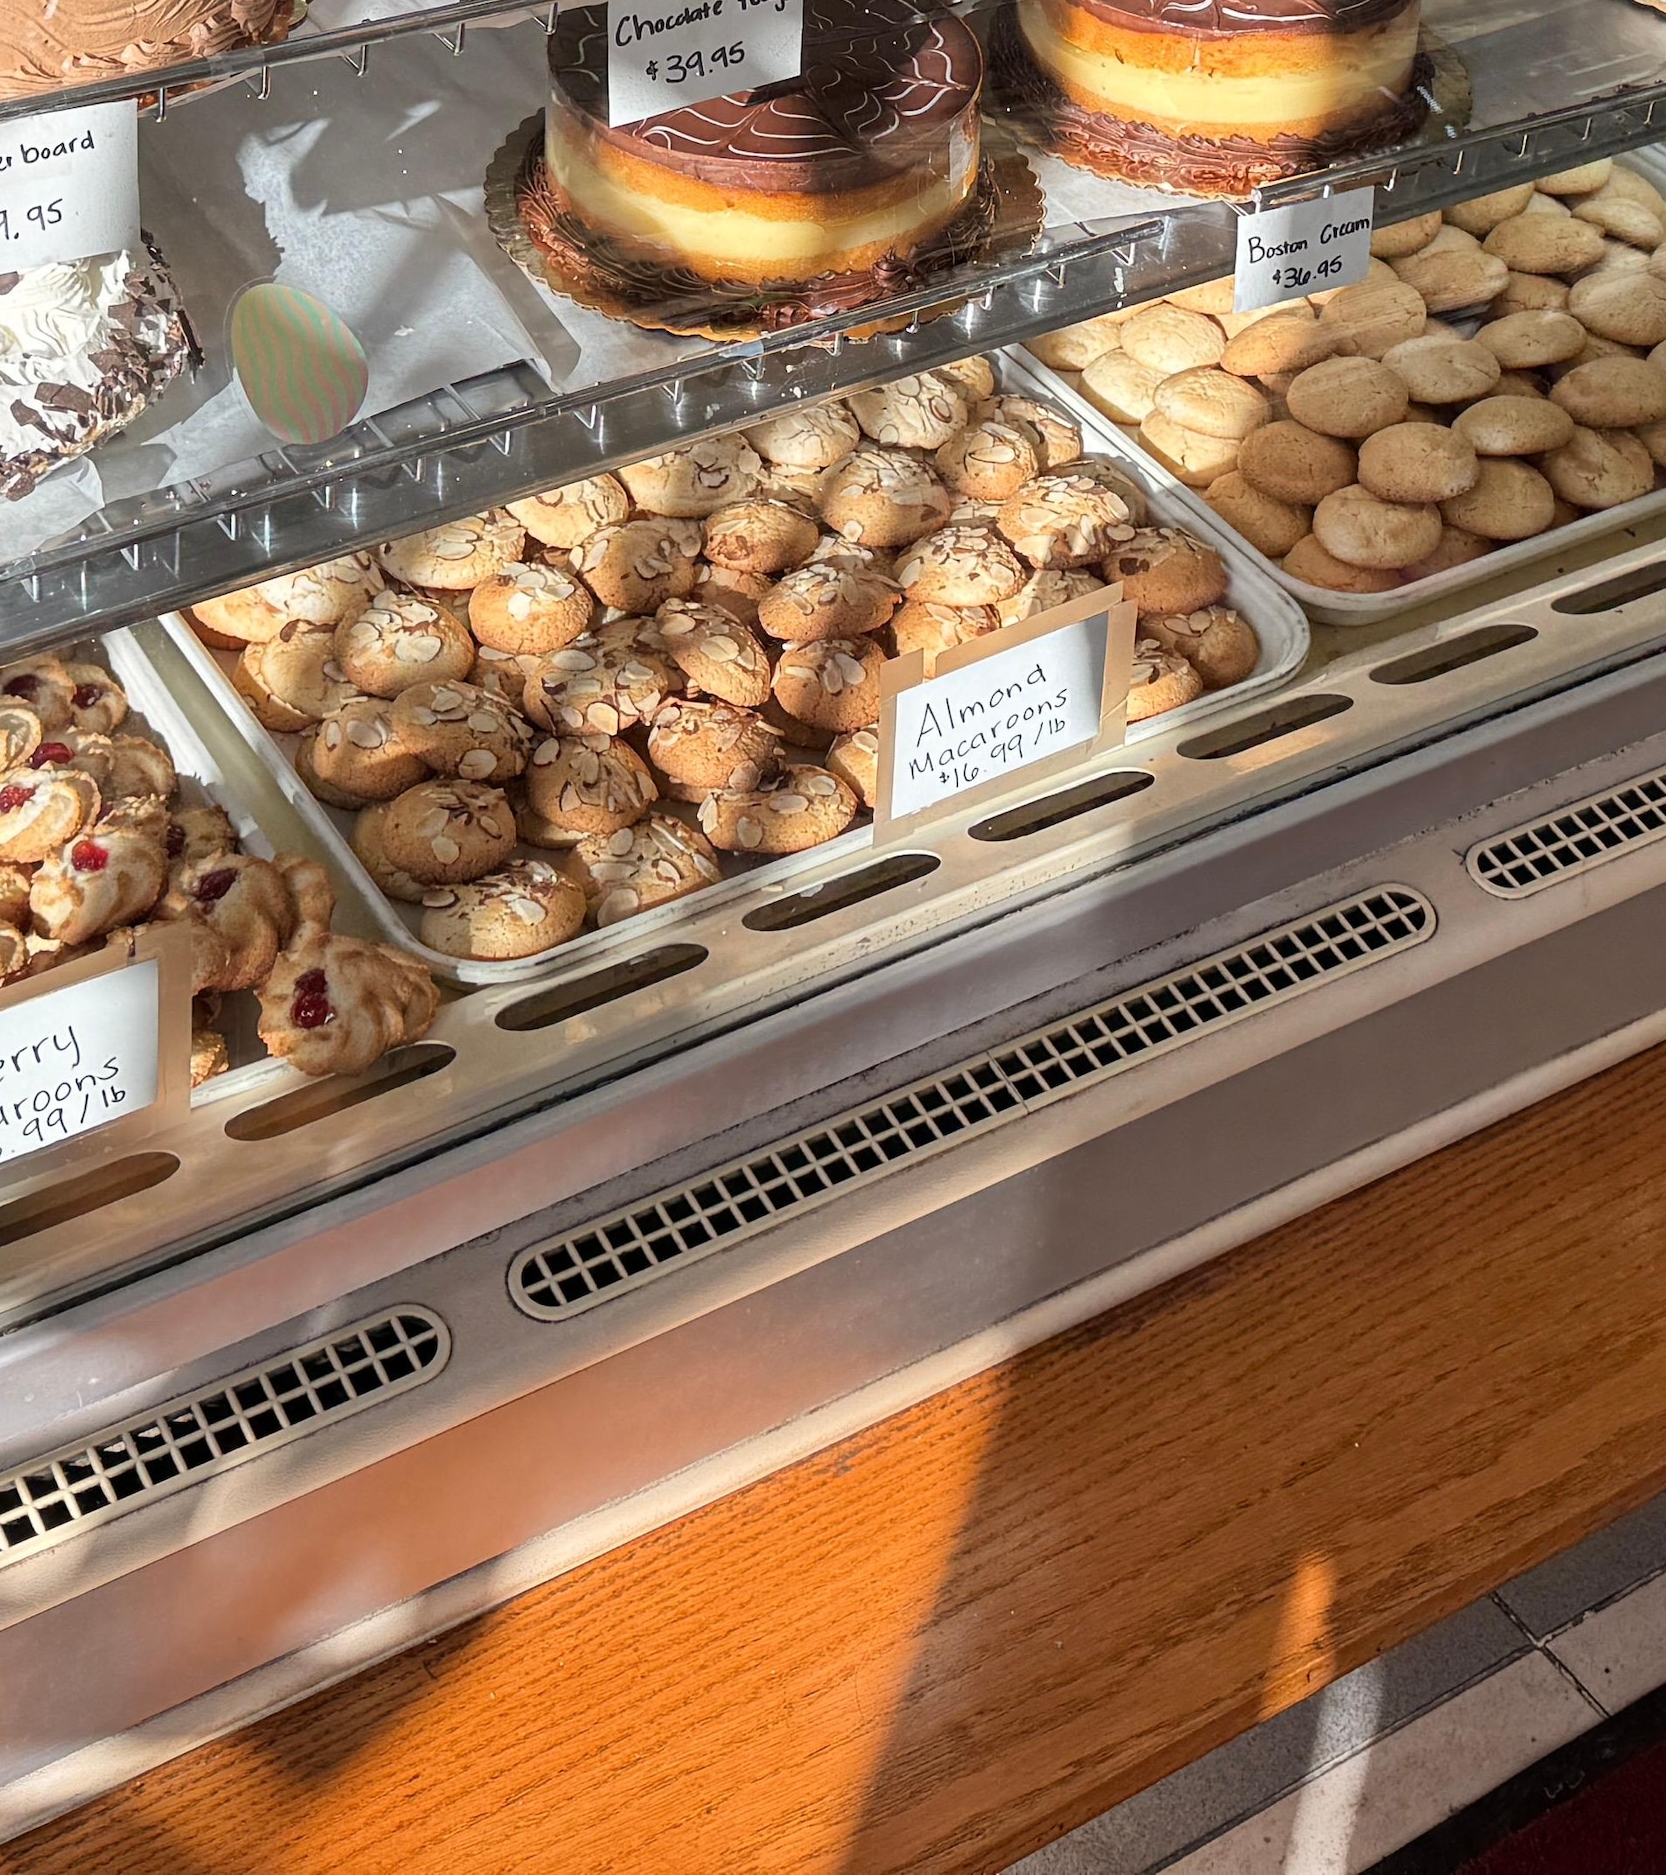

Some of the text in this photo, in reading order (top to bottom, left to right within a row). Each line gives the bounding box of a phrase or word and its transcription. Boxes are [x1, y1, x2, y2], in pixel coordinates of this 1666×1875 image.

[615, 0, 723, 47] Chocolate
[645, 40, 745, 84] $39.95
[1248, 217, 1370, 264] Boston Cream
[1272, 254, 1343, 289] $36.95
[916, 663, 1047, 747] Almond
[908, 688, 1068, 780] Macaroons
